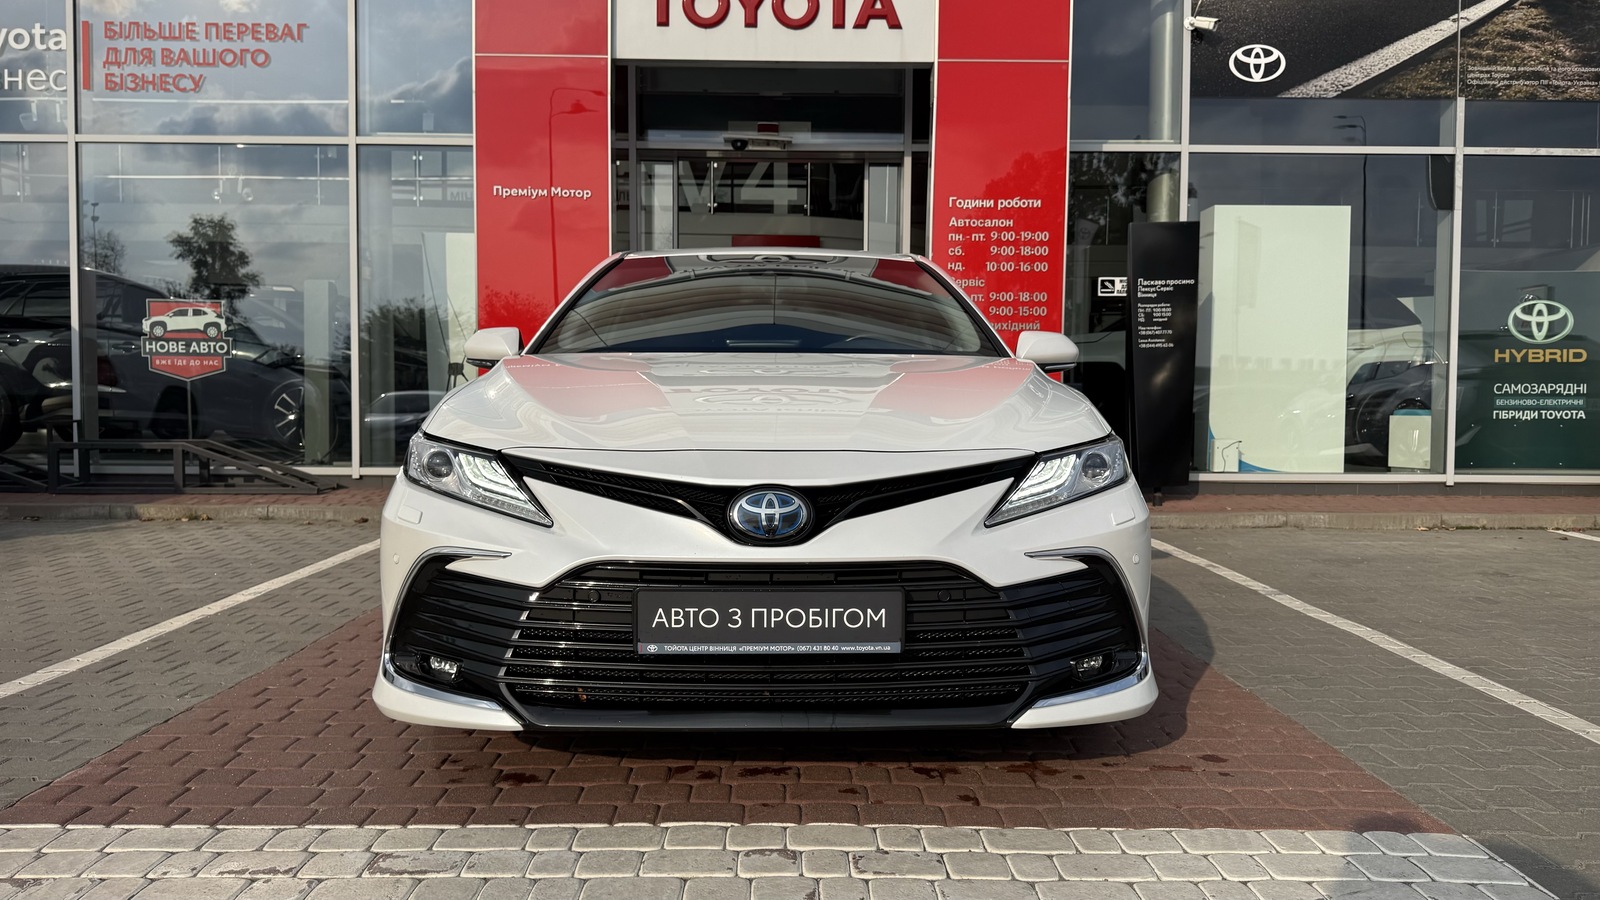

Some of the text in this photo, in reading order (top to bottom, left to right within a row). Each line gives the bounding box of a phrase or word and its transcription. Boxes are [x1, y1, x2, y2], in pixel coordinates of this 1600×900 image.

[103, 21, 309, 42] БІЛЬШЕ ПЕРЕВАГ
[103, 47, 270, 68] ДЛЯ ВАШОГО
[104, 73, 205, 91] БІЗНЕСУ
[493, 185, 592, 200] Преміум Мотор
[949, 197, 1041, 210] Години роботи
[949, 217, 1014, 228] Автосалон
[990, 231, 1049, 242] 9:00-19:00
[948, 246, 1049, 256] сб. 9:00-18:00
[948, 262, 1048, 272] нд. 10:00-16:00
[1166, 279, 1195, 287] просимо
[989, 292, 1048, 302] 9:00-18:00
[989, 306, 1047, 316] 9:00-15:00
[145, 341, 228, 354] НОВЕ АВТО
[1494, 348, 1588, 363] HYBRID
[174, 358, 187, 366] ЇДЕ
[189, 359, 200, 367] ДО
[1493, 383, 1587, 396] САМОЗАРЯДНІ
[1496, 398, 1584, 406] БЕНЗИНОВО-ЕЛЕКТРИЧНІ
[1493, 410, 1586, 420] ГІБРИДИ TOYOTA
[652, 607, 887, 628] АВТО З ПРОБІГОМ
[664, 644, 689, 652] ТОЙОТА
[840, 644, 891, 652] www.toyota.vn.ua
